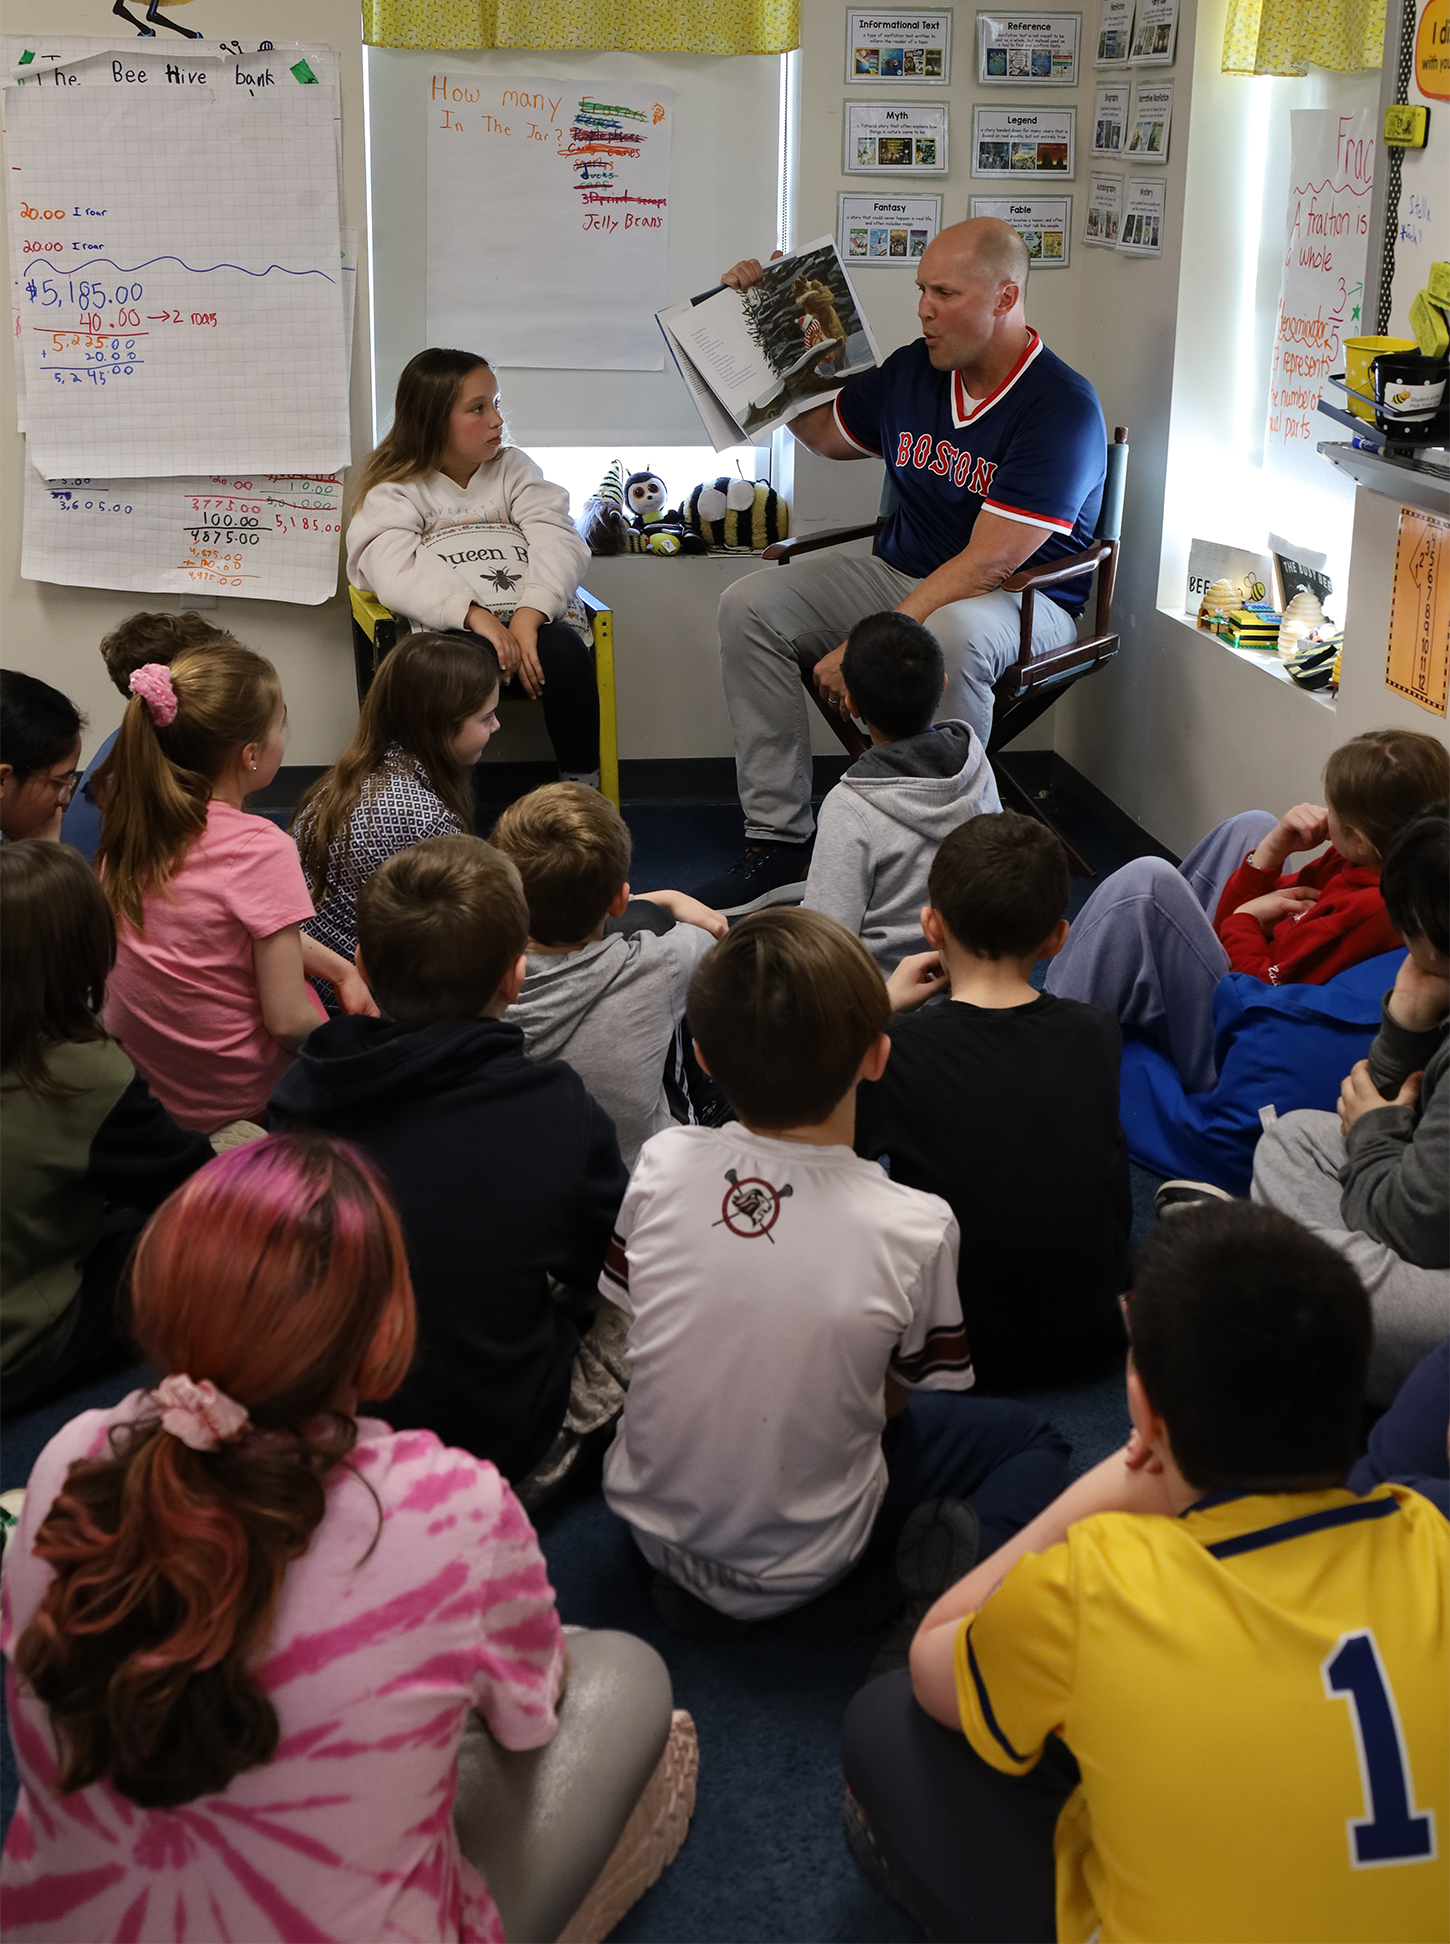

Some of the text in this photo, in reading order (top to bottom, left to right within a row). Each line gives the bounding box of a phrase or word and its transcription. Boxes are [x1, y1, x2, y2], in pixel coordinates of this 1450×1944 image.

[859, 19, 940, 30] Informational Text
[1007, 22, 1051, 31] Reference
[1432, 21, 1437, 45] I
[112, 60, 148, 84] Bee
[165, 63, 207, 85] Hive
[235, 64, 275, 87] bank
[431, 75, 562, 123] How many
[440, 109, 464, 133] In
[481, 115, 511, 137] The
[886, 111, 908, 121] Myth
[1007, 116, 1037, 125] Legend
[20, 201, 66, 220] 20.00
[874, 203, 906, 213] Fantasy
[1290, 200, 1300, 239] A
[1307, 196, 1350, 237] fraction
[1355, 205, 1368, 235] is
[582, 213, 619, 234] Jelly
[22, 240, 63, 253] 20.00
[1299, 244, 1333, 273] whole
[26, 278, 143, 311] $5,185.00
[1332, 276, 1347, 314] 3
[79, 307, 141, 334] 40.00
[172, 309, 184, 324] 2
[52, 333, 135, 353] 5,225.00
[1328, 325, 1340, 362] 5
[1283, 351, 1330, 385] represents
[1281, 386, 1312, 411] number
[1284, 413, 1311, 446] parts
[895, 431, 998, 497] BOSTON
[203, 511, 259, 527] 100.00
[275, 514, 341, 535] 5,185.00
[1425, 540, 1431, 556] 3
[1419, 552, 1425, 568] 2
[1429, 551, 1435, 567] 5
[1283, 561, 1298, 574] THE
[1298, 563, 1317, 581] BUSY
[1415, 563, 1419, 579] 1
[1427, 568, 1433, 584] 6
[1189, 575, 1211, 595] BEE
[1426, 586, 1432, 601] 7
[1424, 604, 1431, 619] 8
[1423, 621, 1430, 637] 9
[1421, 638, 1429, 654] 10
[1420, 656, 1427, 673] 11
[1418, 674, 1426, 691] 12
[1319, 1626, 1438, 1871] 1
